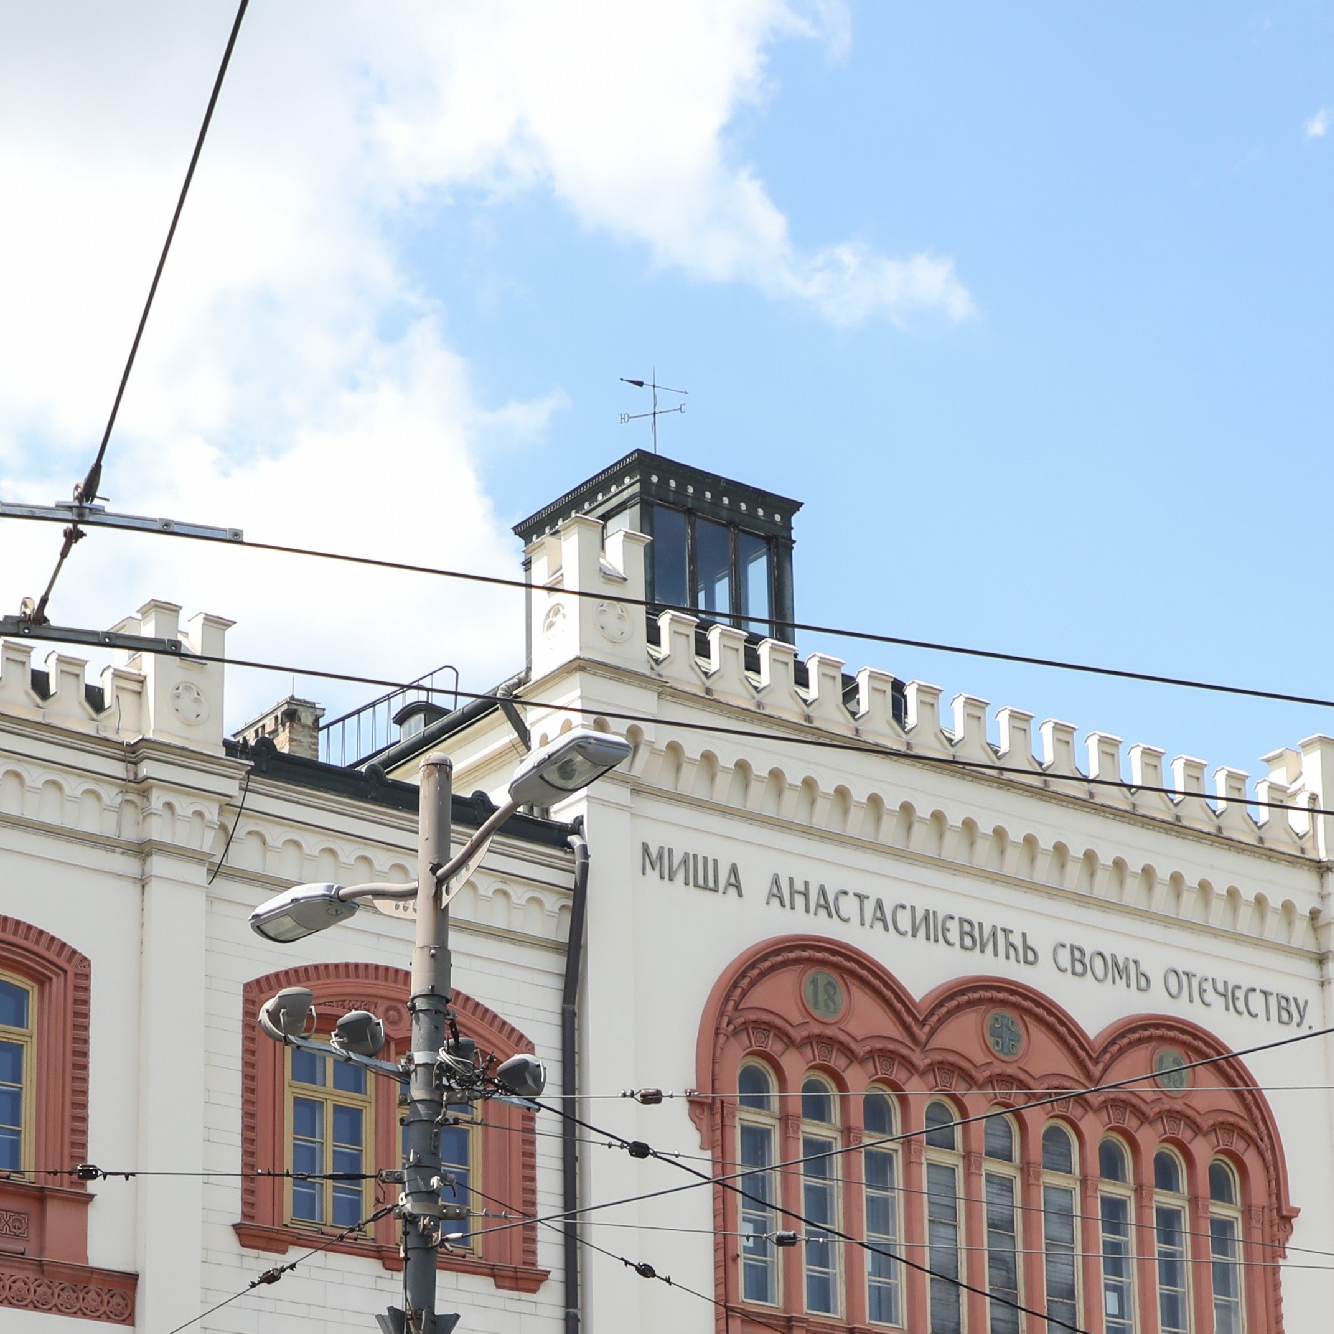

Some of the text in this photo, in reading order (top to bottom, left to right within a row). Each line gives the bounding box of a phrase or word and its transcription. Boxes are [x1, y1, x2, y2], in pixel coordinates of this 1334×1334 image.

[641, 841, 744, 898] МИША
[1052, 942, 1152, 992] СВОМЪ
[810, 976, 838, 1014] 18
